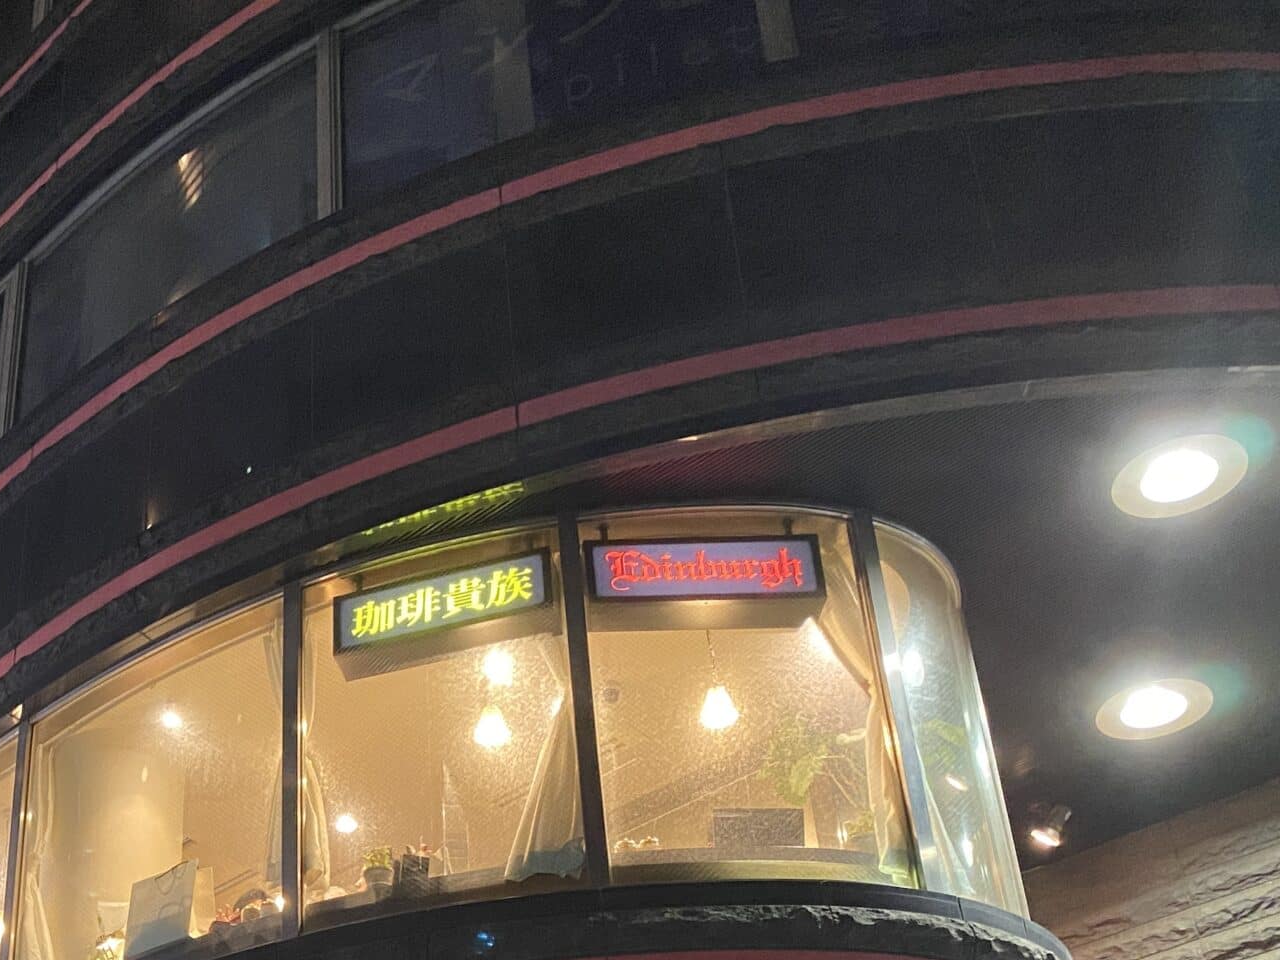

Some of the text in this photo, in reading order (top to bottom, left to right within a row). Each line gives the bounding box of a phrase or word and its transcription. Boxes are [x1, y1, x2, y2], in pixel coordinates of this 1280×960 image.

[605, 547, 802, 591] Edinburgh
[352, 567, 532, 637] 珈琲貴族
